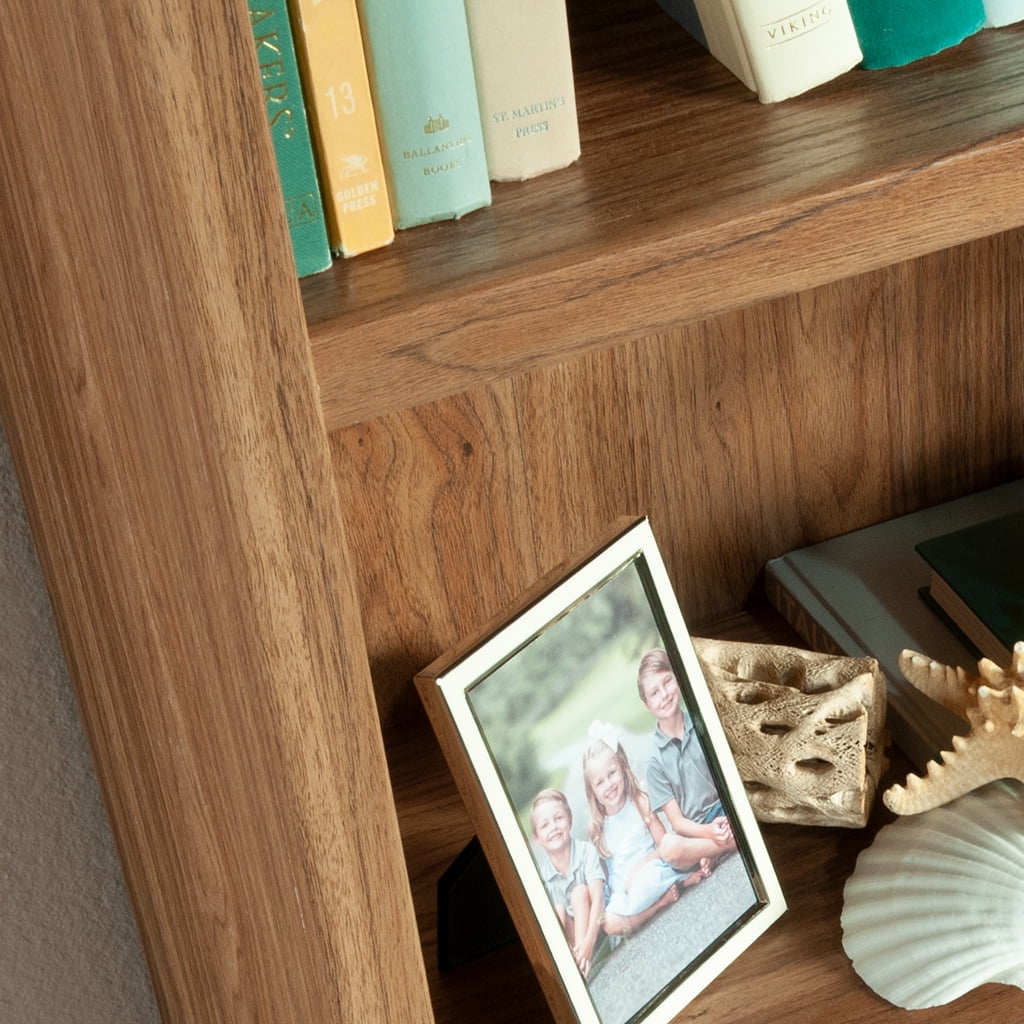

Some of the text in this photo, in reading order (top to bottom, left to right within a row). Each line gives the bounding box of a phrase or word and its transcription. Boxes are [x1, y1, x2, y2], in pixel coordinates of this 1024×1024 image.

[767, 5, 832, 39] VIKING
[324, 81, 357, 118] 13
[512, 96, 566, 119] MARTIN'S
[516, 121, 550, 138] PRESS
[336, 181, 379, 202] GOLDEN
[342, 194, 377, 213] PRESS
